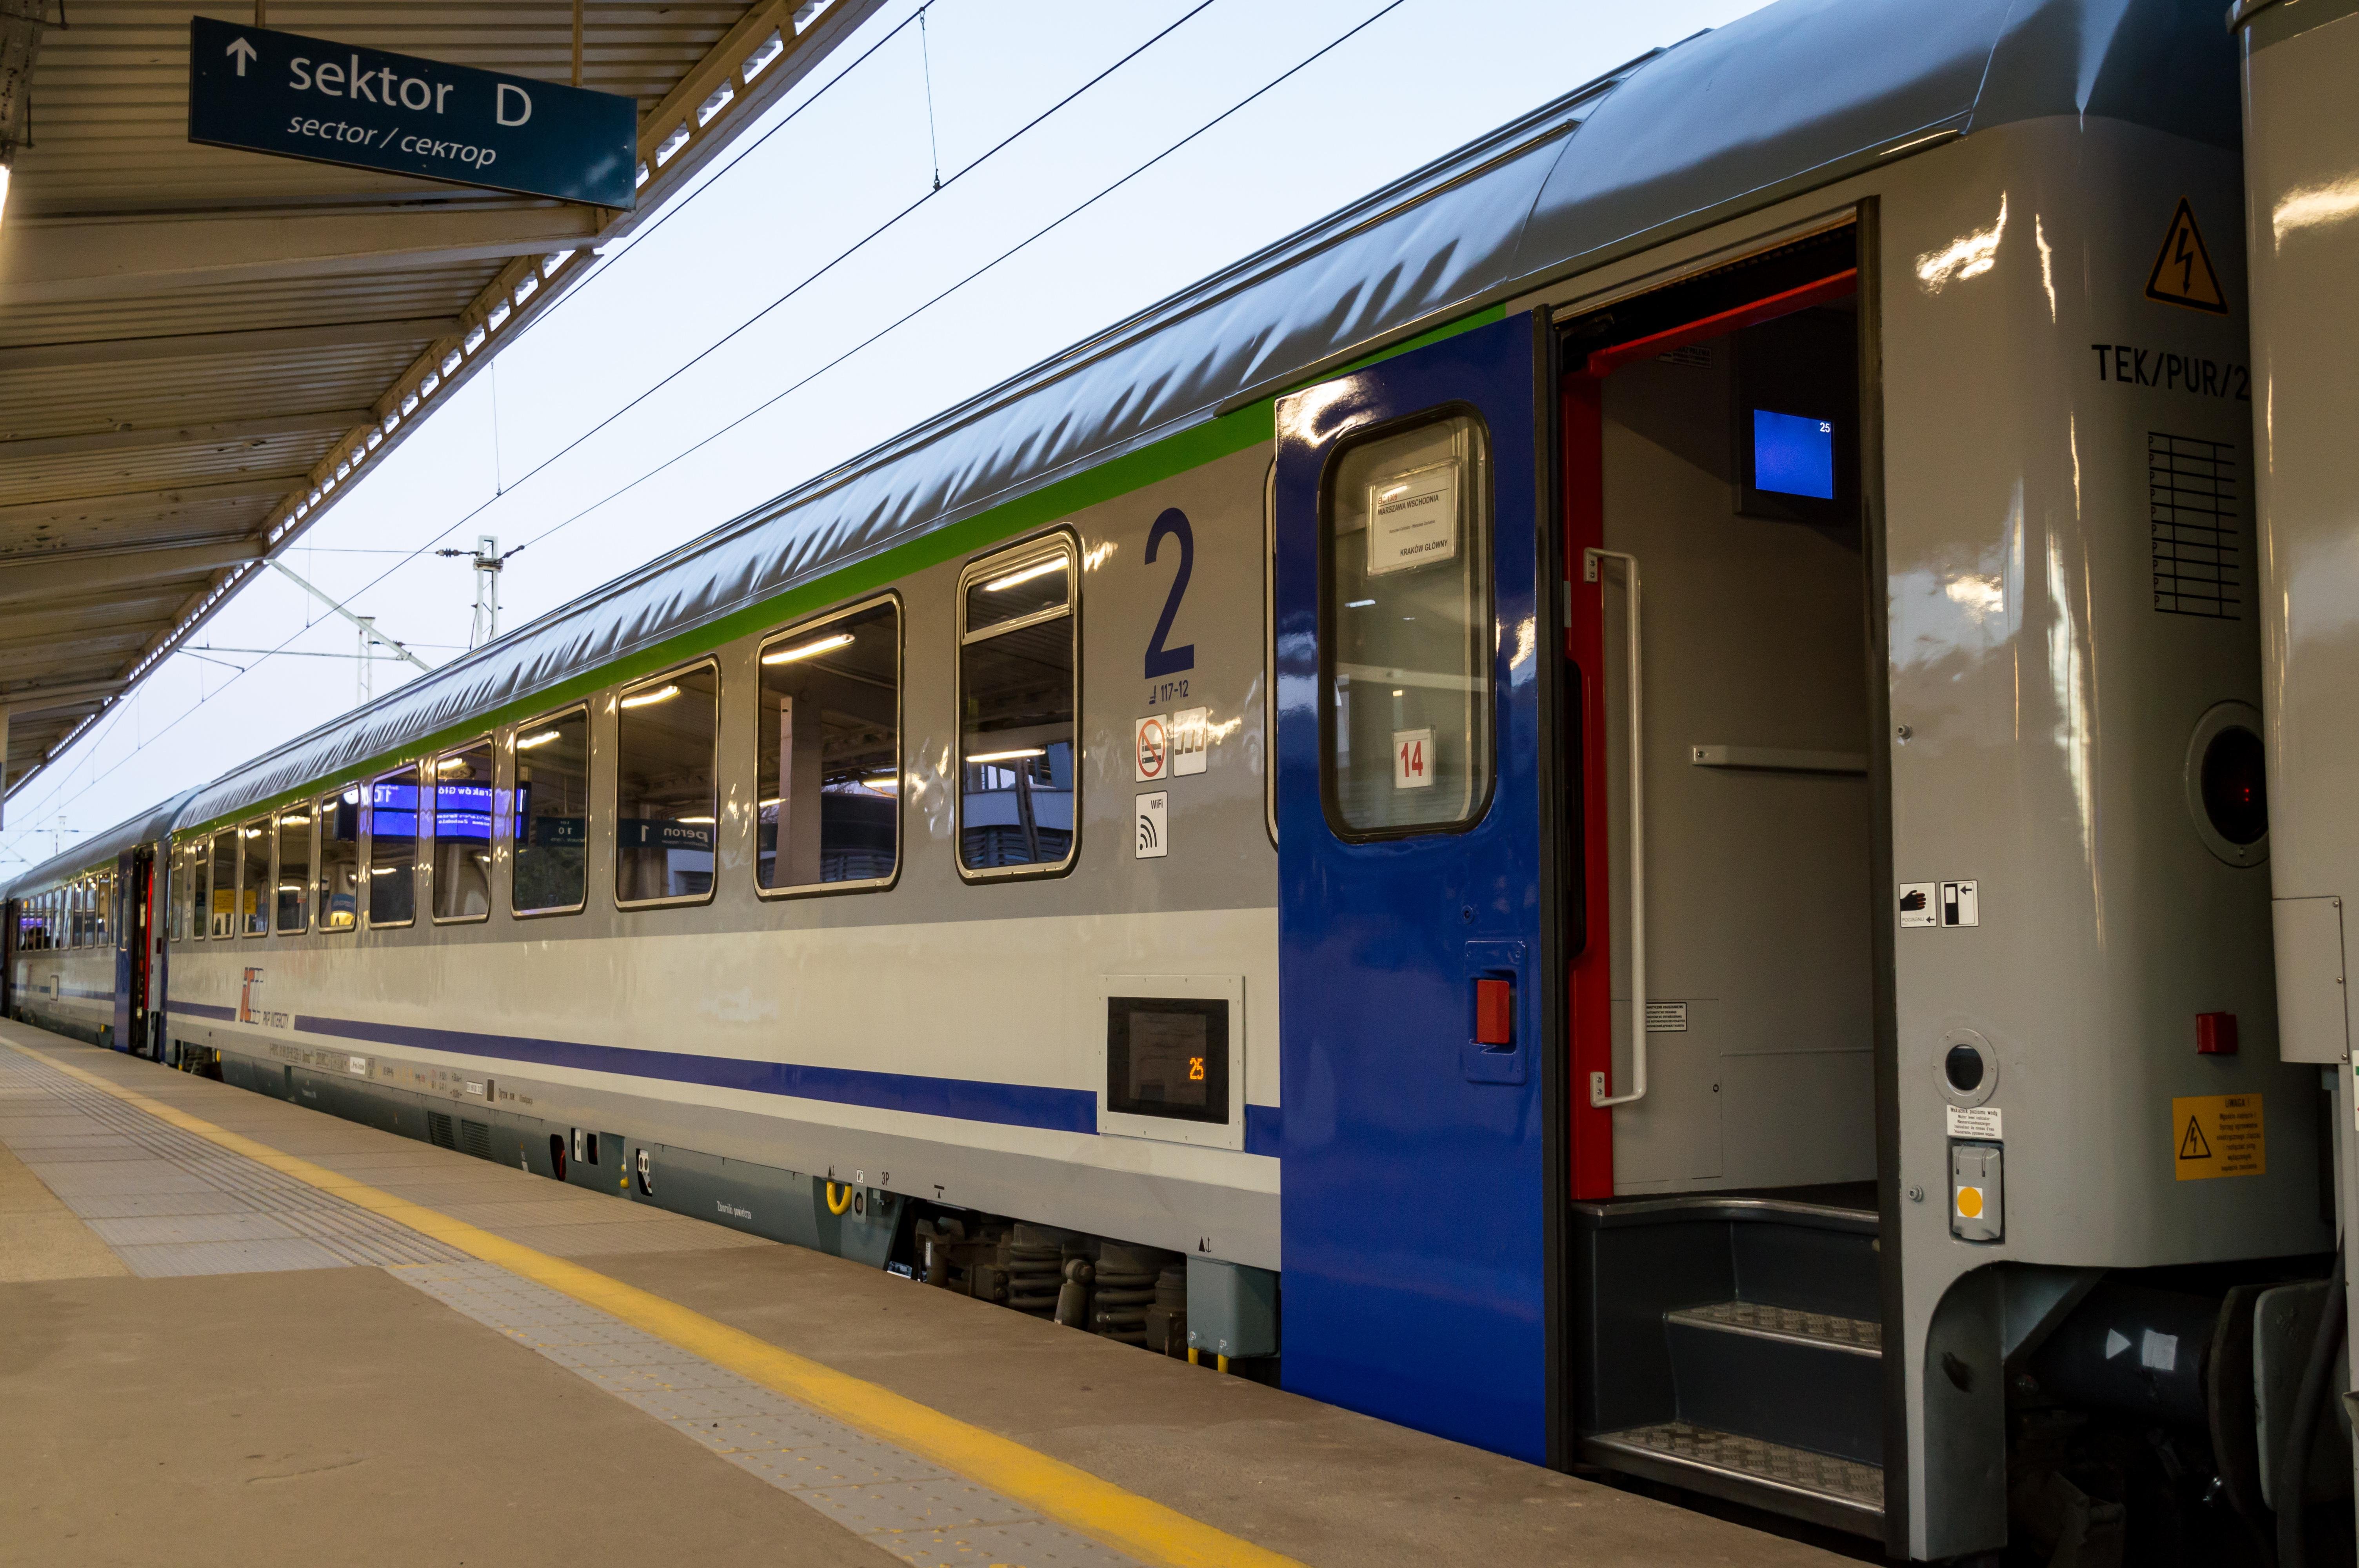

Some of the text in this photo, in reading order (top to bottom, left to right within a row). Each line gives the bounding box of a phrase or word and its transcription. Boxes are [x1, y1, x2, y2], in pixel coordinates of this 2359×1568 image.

[289, 54, 532, 127] sektor D
[287, 115, 377, 146] sector
[379, 128, 398, 149] /
[1820, 422, 1830, 433] 25
[1378, 494, 1439, 515] WARSZAWA WSCHODNIA
[1400, 539, 1448, 556] KRAKÓW GŁÓWNY
[1144, 507, 1194, 679] 2
[1161, 679, 1189, 702] 117-12
[1401, 740, 1423, 777] 14
[1150, 798, 1163, 809] WiFi
[1189, 1058, 1204, 1080] 25
[2225, 1098, 2245, 1108] UWAGA
[881, 1171, 889, 1186] 3P
